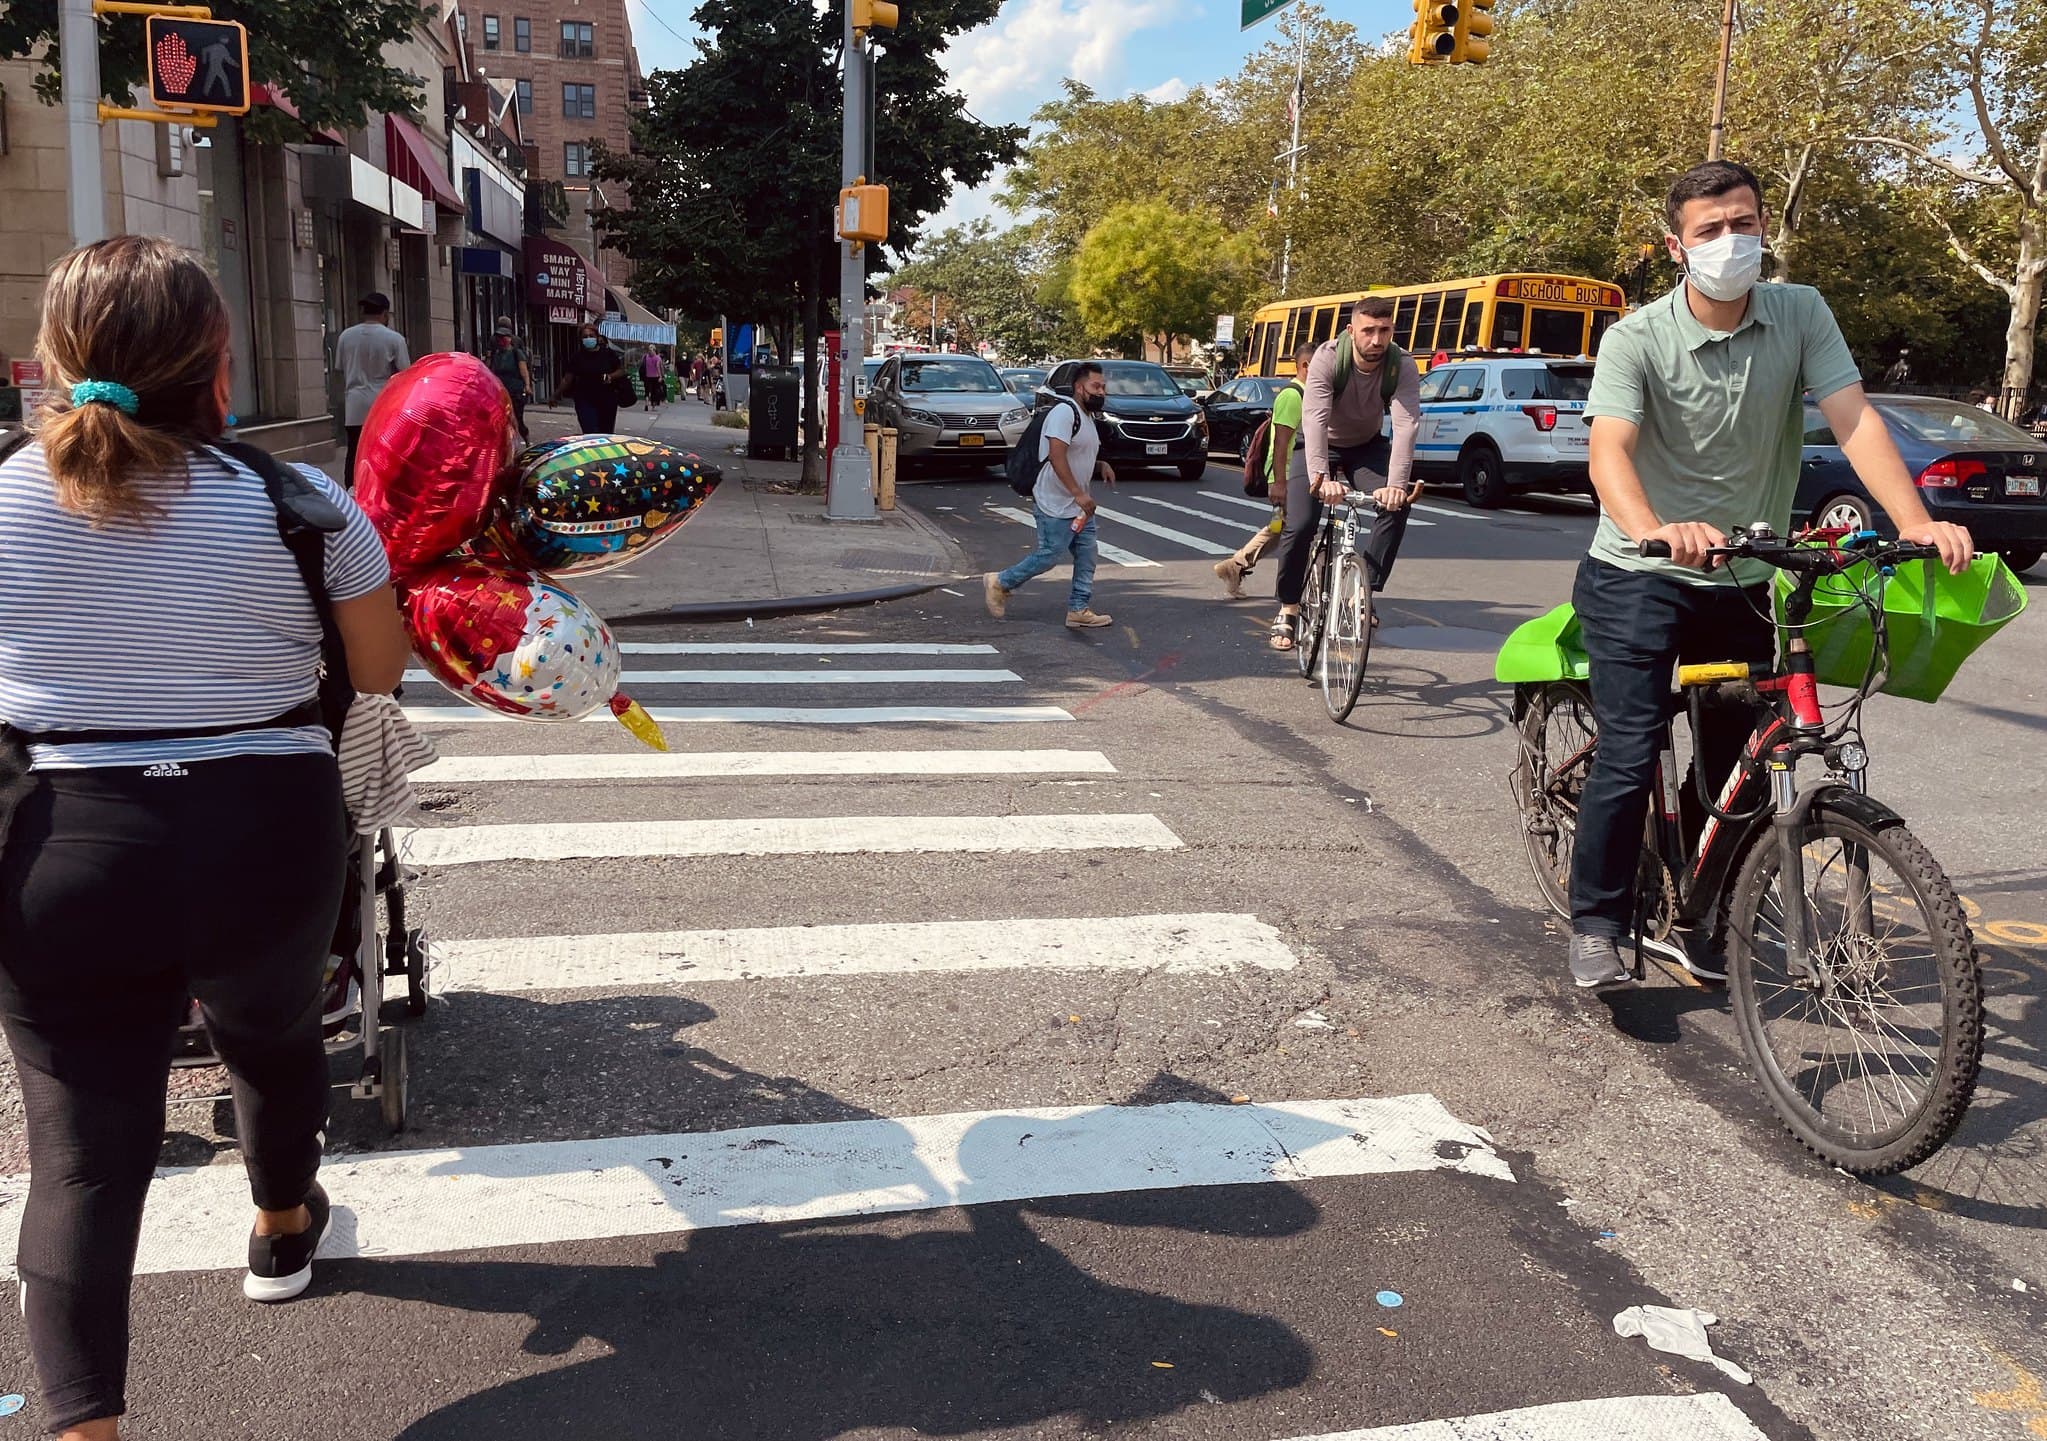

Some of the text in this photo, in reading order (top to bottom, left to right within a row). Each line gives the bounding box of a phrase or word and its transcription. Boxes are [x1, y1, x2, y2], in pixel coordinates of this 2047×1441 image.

[543, 254, 577, 266] SMART
[550, 266, 570, 277] WAY
[550, 277, 570, 288] MINI
[546, 288, 574, 300] MART
[1522, 282, 1598, 303] SCHOOL BUS
[552, 306, 575, 318] ATM
[143, 768, 189, 777] adidas
